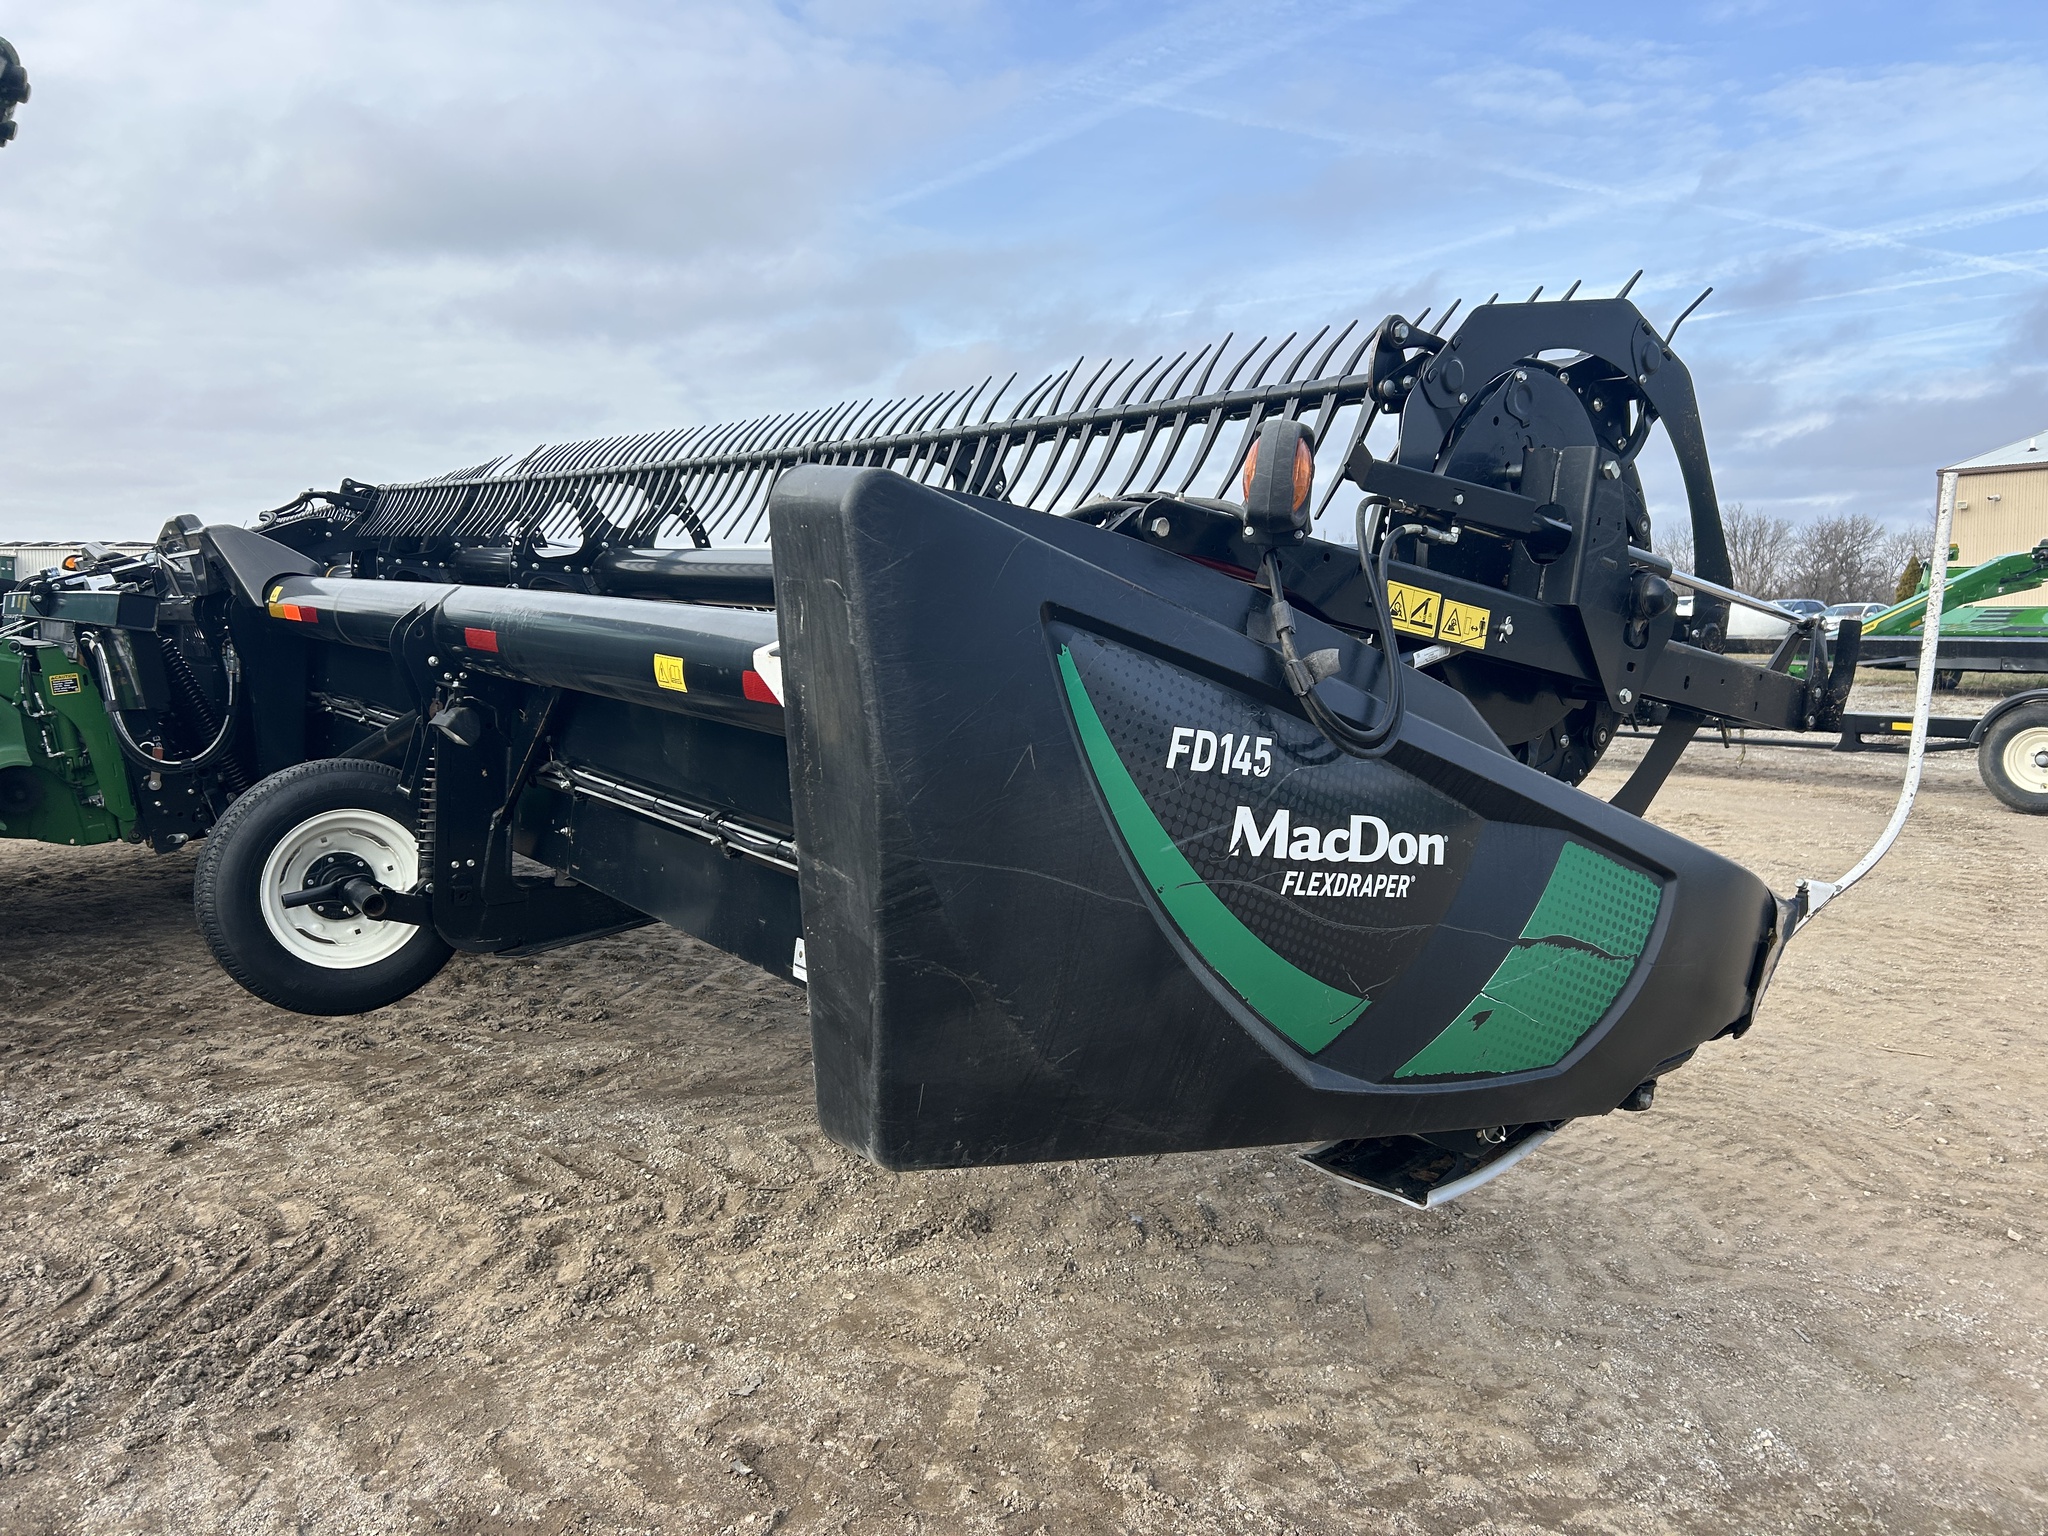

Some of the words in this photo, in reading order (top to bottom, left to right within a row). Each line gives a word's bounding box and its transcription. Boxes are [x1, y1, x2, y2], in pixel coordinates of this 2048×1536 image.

[1165, 726, 1273, 778] FD145
[1229, 806, 1445, 866] MacDon
[1281, 870, 1411, 898] FLEXDRAPER
